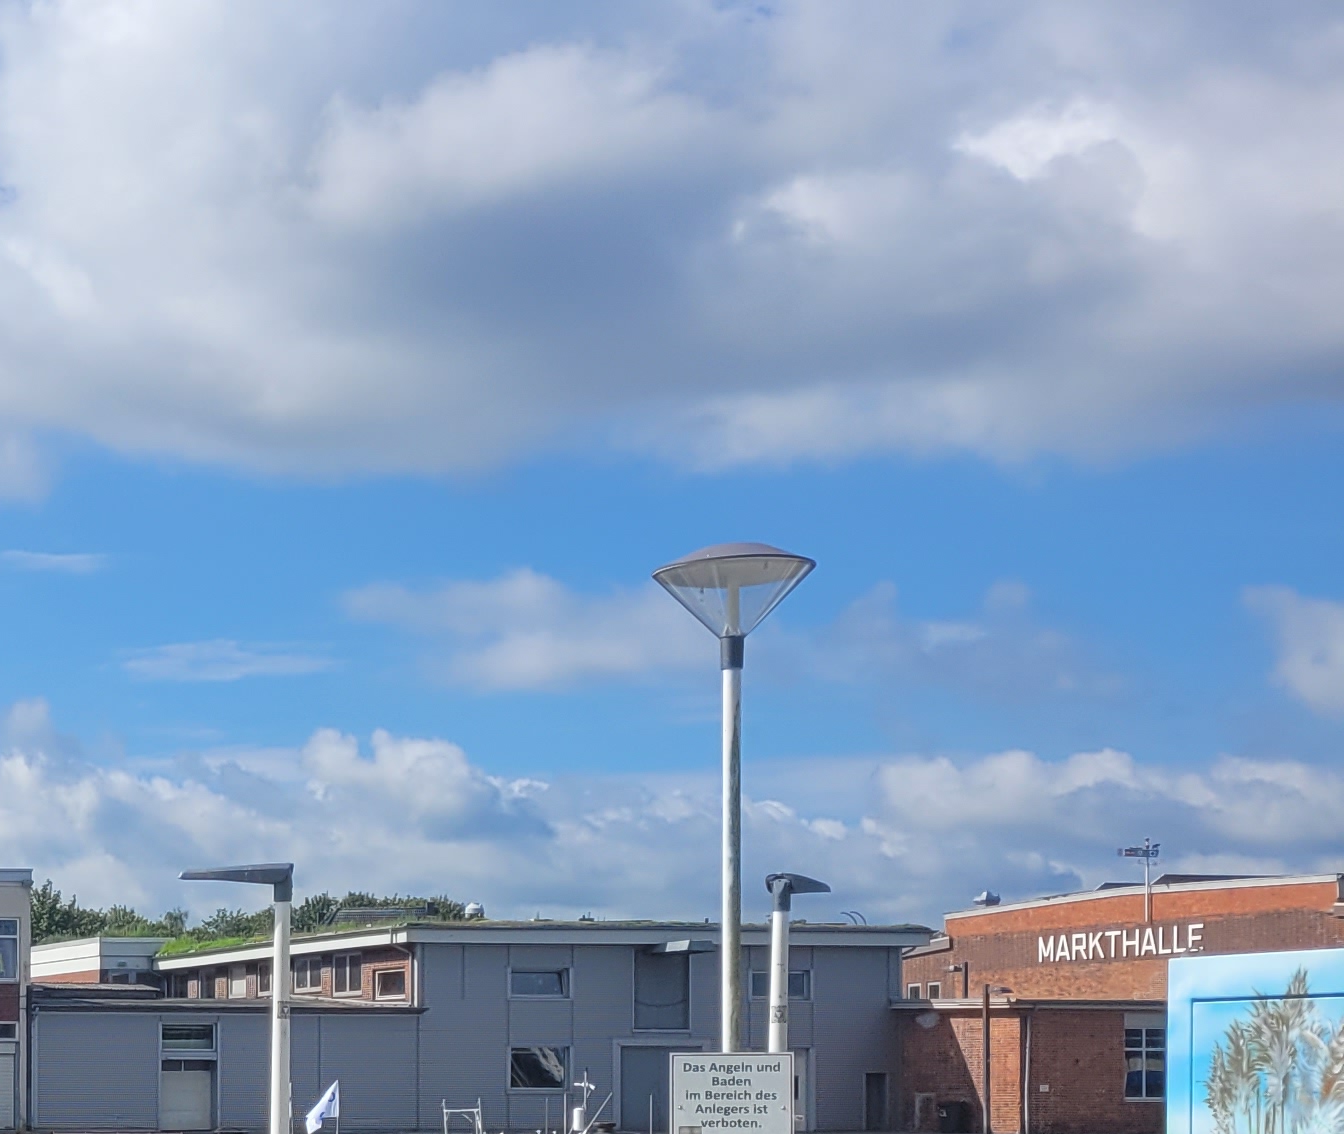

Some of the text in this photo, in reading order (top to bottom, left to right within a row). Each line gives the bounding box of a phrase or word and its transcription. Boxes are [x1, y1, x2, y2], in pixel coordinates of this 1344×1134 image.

[1038, 923, 1204, 963] MARKTHALLE
[683, 1062, 781, 1074] Das Angeln und
[712, 1076, 752, 1087] Baden
[685, 1090, 777, 1100] im Bereich des
[695, 1104, 768, 1116] Anlegers ist
[700, 1118, 762, 1128] verboten.
